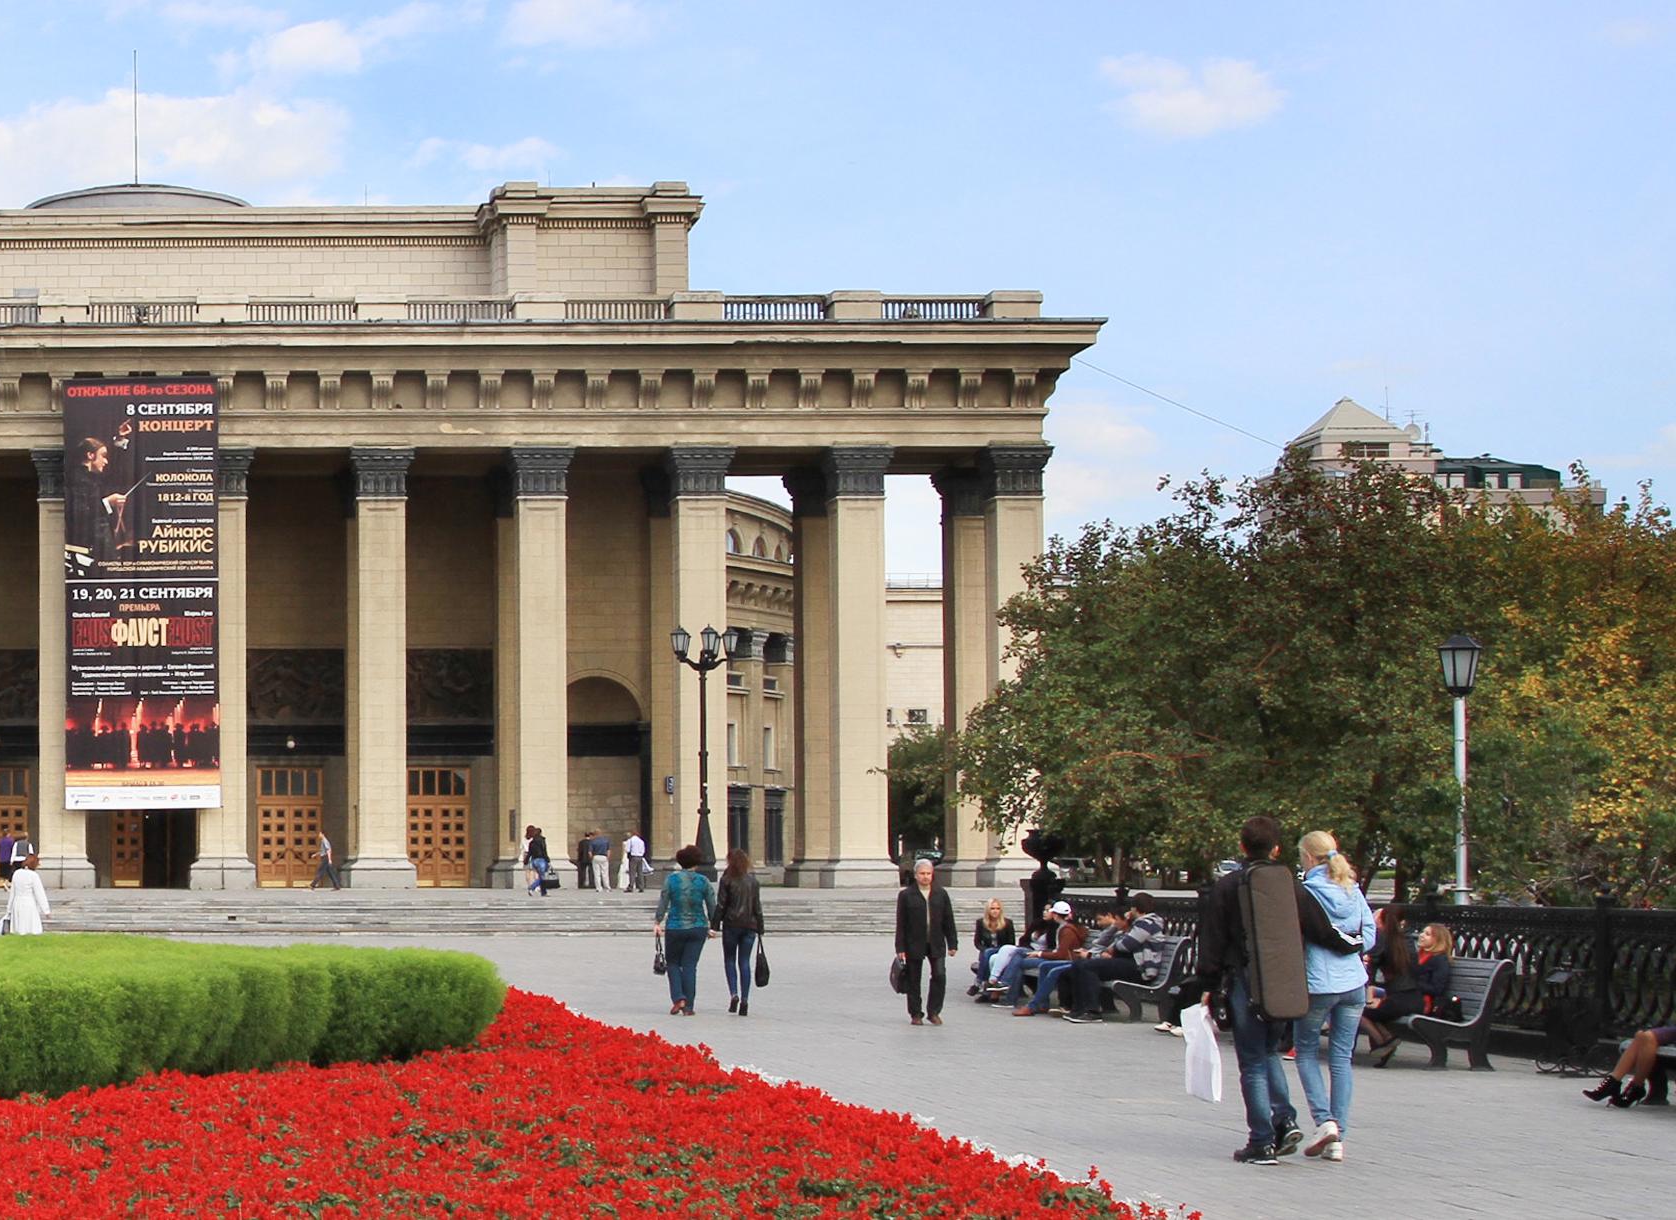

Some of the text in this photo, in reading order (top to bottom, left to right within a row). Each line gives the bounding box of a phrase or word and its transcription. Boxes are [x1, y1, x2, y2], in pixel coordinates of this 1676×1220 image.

[67, 384, 214, 398] ОТКРЫТИЕ 68-го СЕЗОНА
[126, 403, 214, 416] 8 СЕНТЯБРЯ
[138, 420, 214, 433] КОНЦЕРТ
[155, 473, 214, 483] КОЛОКОЛА
[192, 492, 214, 502] ГОД
[152, 525, 214, 539] Айнарс
[139, 540, 214, 553] РУБИКИС
[72, 587, 214, 601] 19, 20, 21 СЕНТЯБРЯ
[119, 603, 160, 612] ПРЕМЬЕРА
[72, 618, 113, 647] FAUS
[111, 618, 169, 647] ФАУСТ
